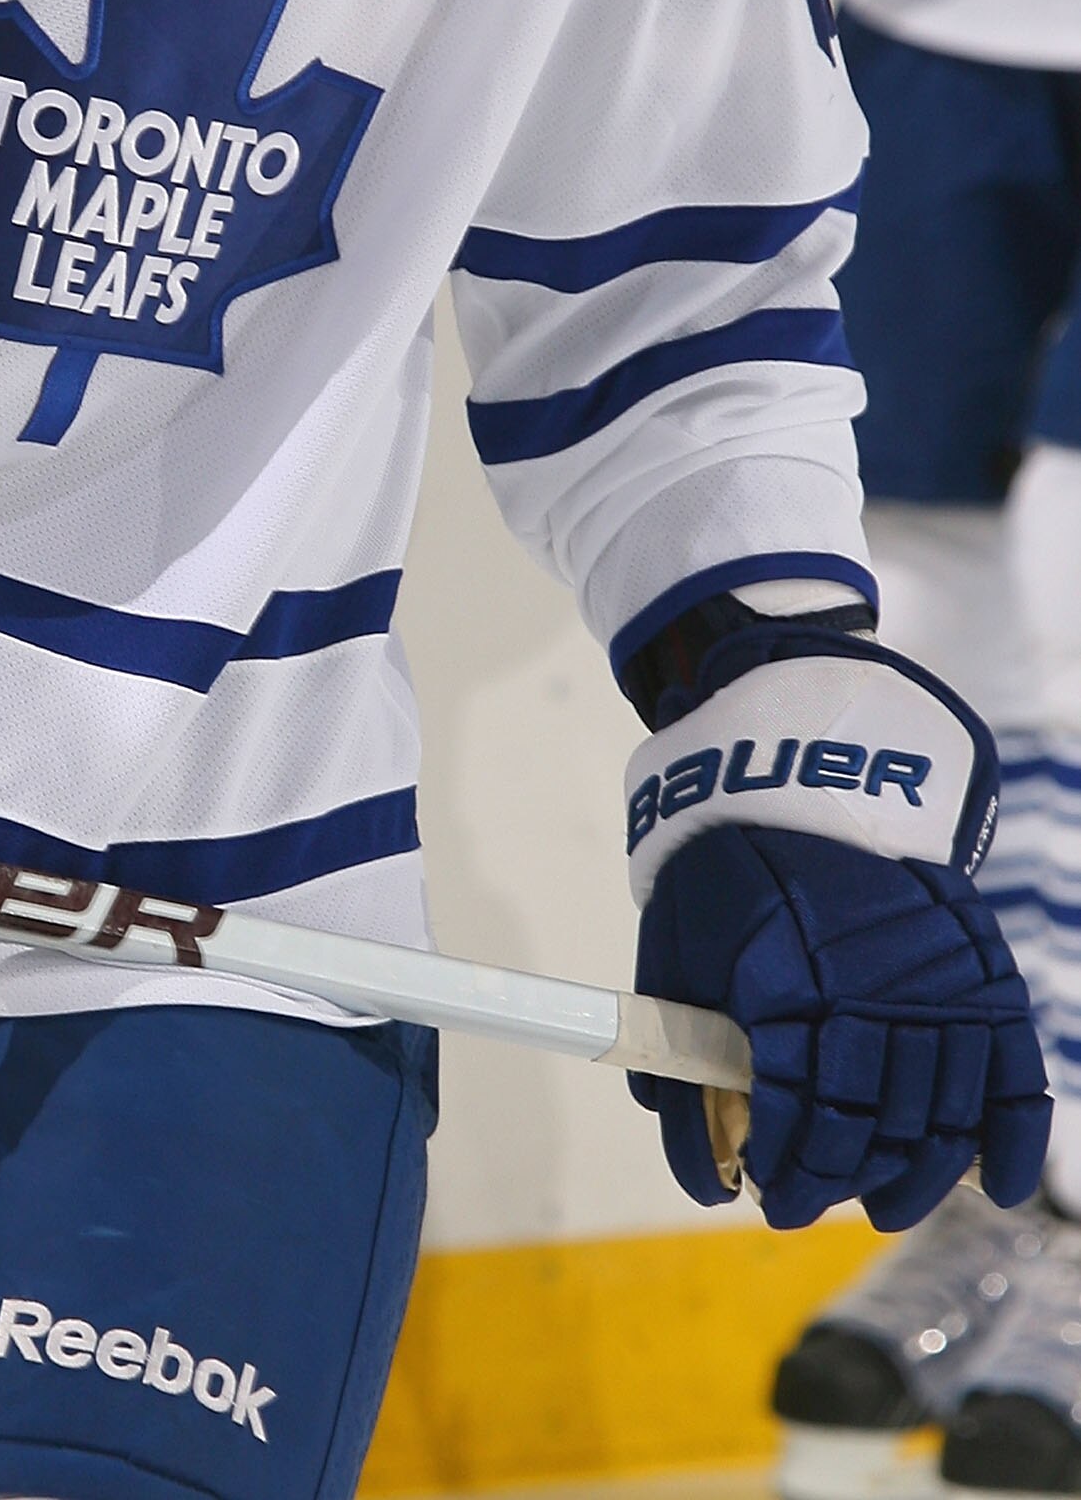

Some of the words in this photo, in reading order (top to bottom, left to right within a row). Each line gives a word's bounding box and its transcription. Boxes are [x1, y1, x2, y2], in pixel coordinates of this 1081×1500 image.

[11, 159, 234, 260] MAPLE
[13, 232, 200, 324] LEAFS
[626, 739, 933, 856] BAUER
